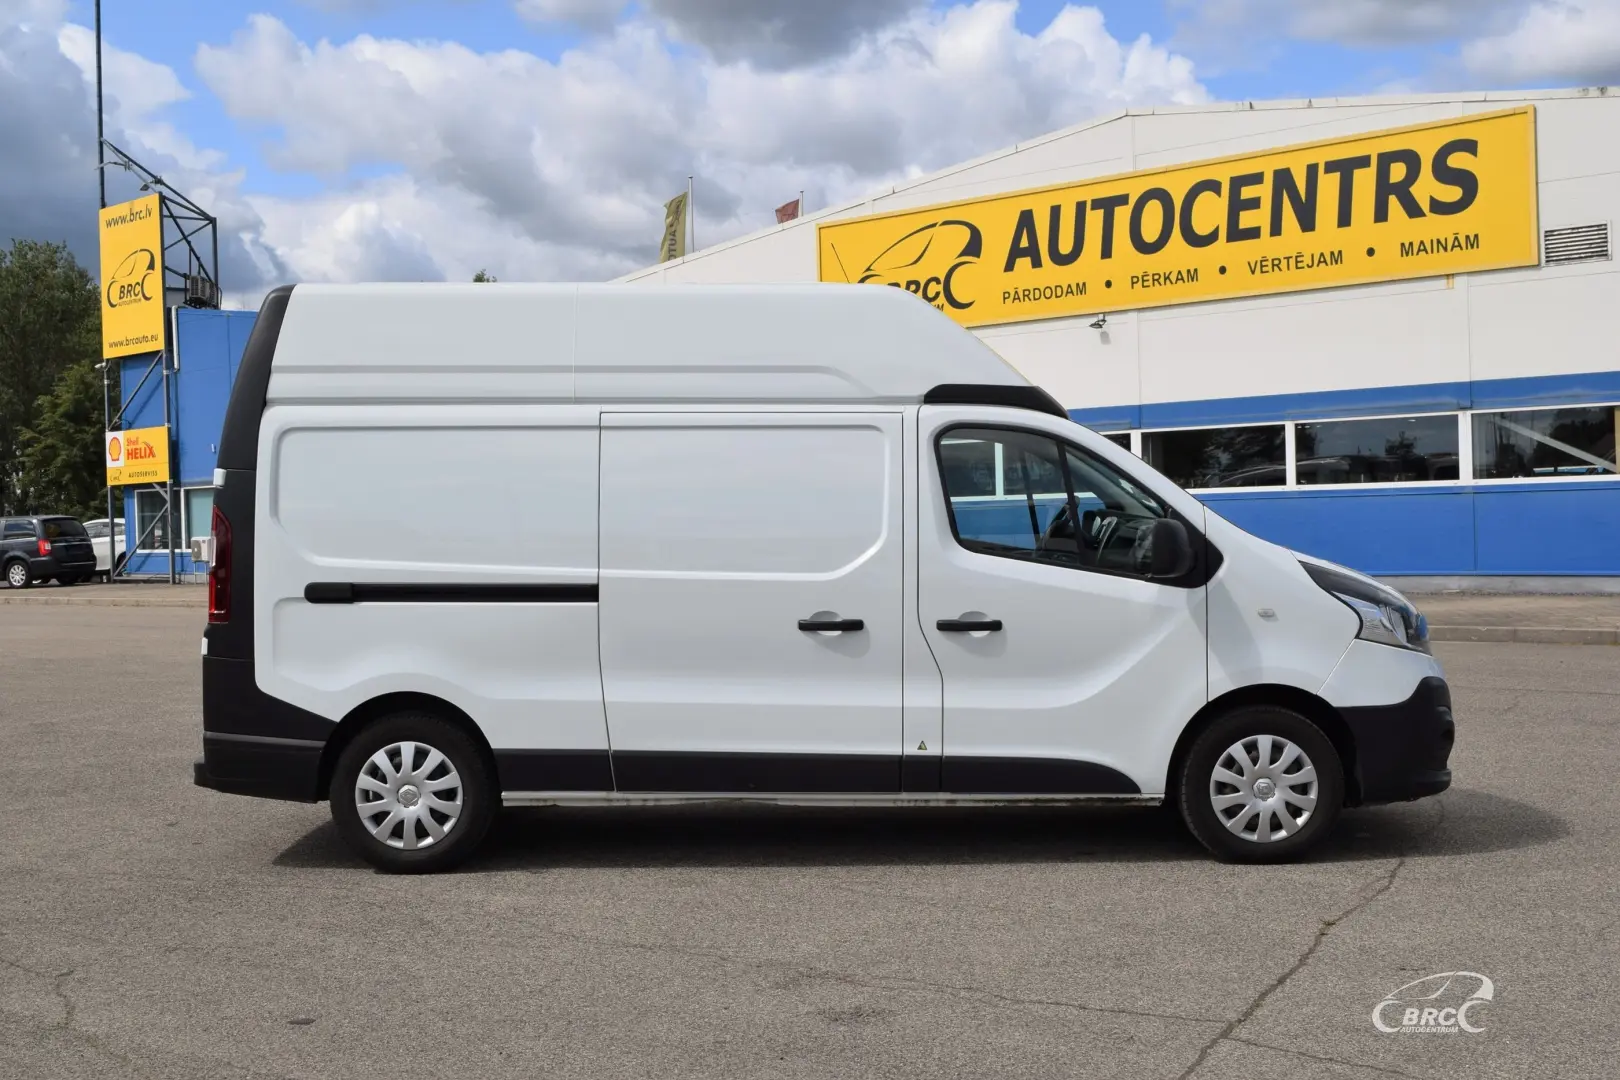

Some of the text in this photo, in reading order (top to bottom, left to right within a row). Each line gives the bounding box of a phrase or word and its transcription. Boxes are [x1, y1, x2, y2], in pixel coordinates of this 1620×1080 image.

[1003, 138, 1479, 273] AUTOCENTRS
[105, 204, 153, 229] www.brc.lv
[1002, 232, 1479, 304] PĀRDODAM PĒRKAM VĒRTĒJAM MAINĀM
[108, 333, 158, 349] www.brcauto.eu
[126, 437, 139, 447] Shell
[127, 444, 156, 460] HELIX
[128, 470, 158, 478] AUTOSERVISS
